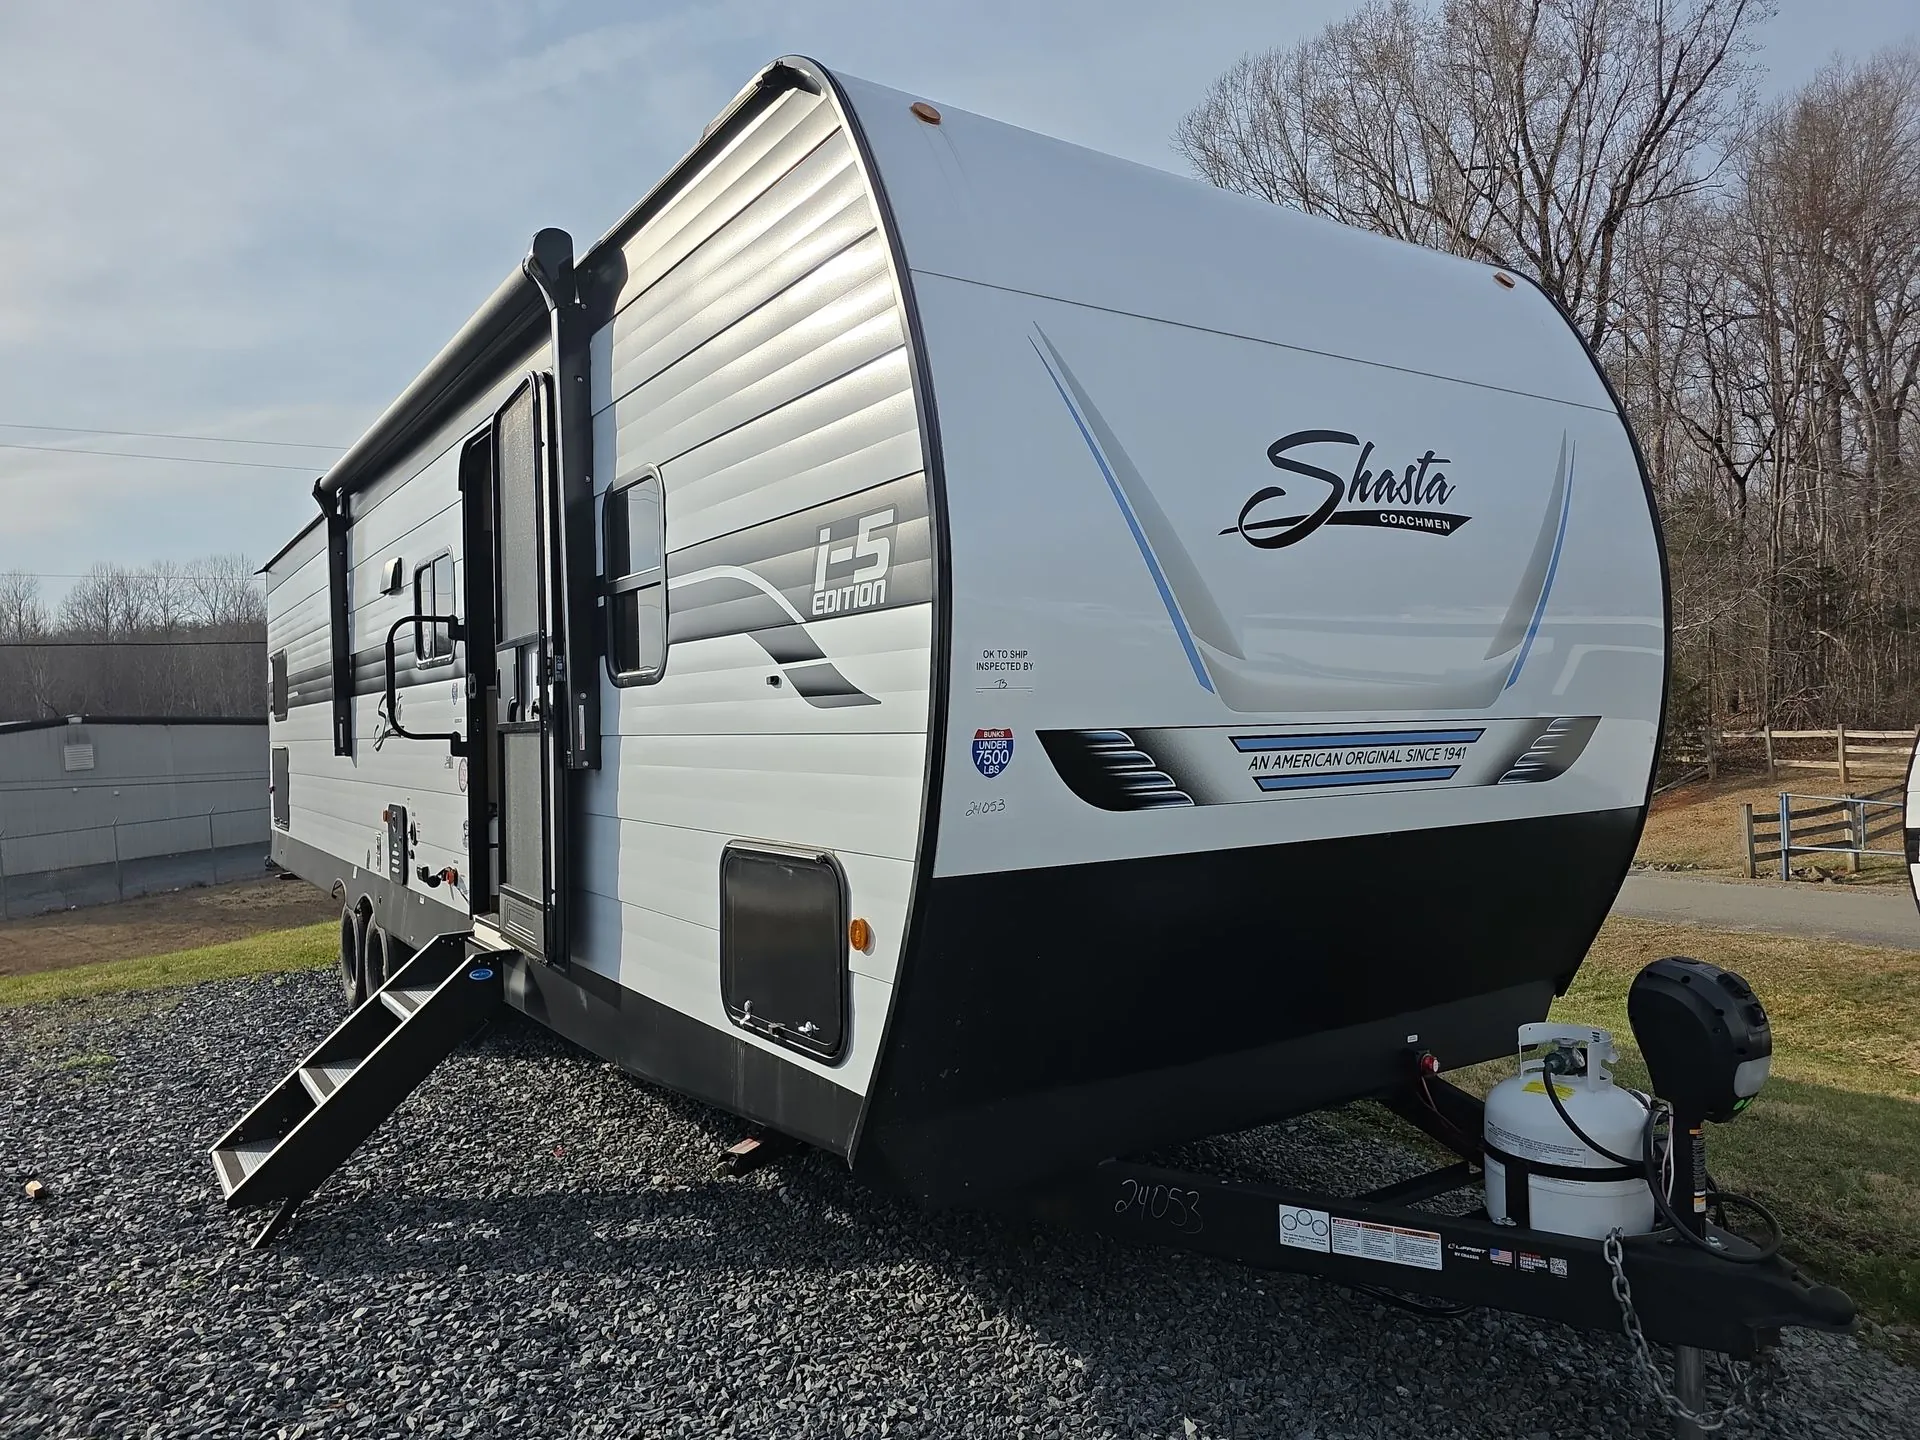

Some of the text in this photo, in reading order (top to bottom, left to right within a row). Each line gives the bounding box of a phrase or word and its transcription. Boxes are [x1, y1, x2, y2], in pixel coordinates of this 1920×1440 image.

[1238, 429, 1456, 549] Shasta
[1380, 512, 1451, 531] COACHMEN
[812, 579, 887, 616] EDITION
[983, 650, 1028, 659] OK TO SHIP
[976, 662, 1034, 671] INSPECTED BY
[979, 740, 1008, 750] UNDER
[976, 749, 1009, 765] 7500
[1248, 746, 1467, 771] AN AMERICAN ORIGINAL SINCE 1941
[983, 765, 1000, 775] LBS
[965, 798, 1006, 817] 24053
[1115, 1179, 1203, 1234] 24053
